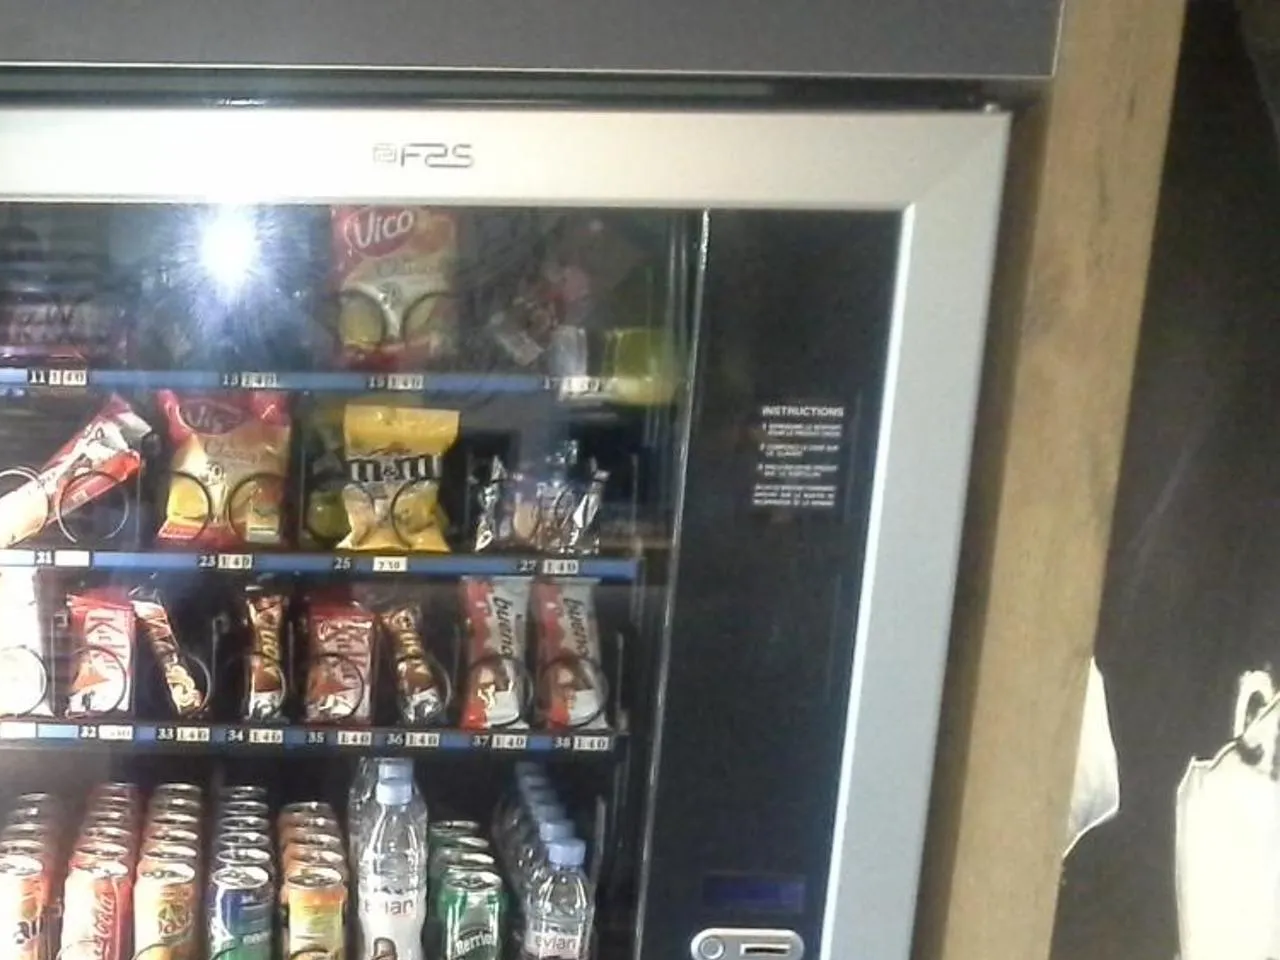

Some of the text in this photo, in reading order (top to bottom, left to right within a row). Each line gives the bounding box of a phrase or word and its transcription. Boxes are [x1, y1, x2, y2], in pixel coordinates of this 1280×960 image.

[762, 406, 844, 417] INSTRUCTIONS
[335, 557, 351, 569] 25
[228, 730, 243, 741] 34
[387, 734, 403, 744] 36
[473, 736, 489, 747] 37
[534, 933, 577, 950] evian
